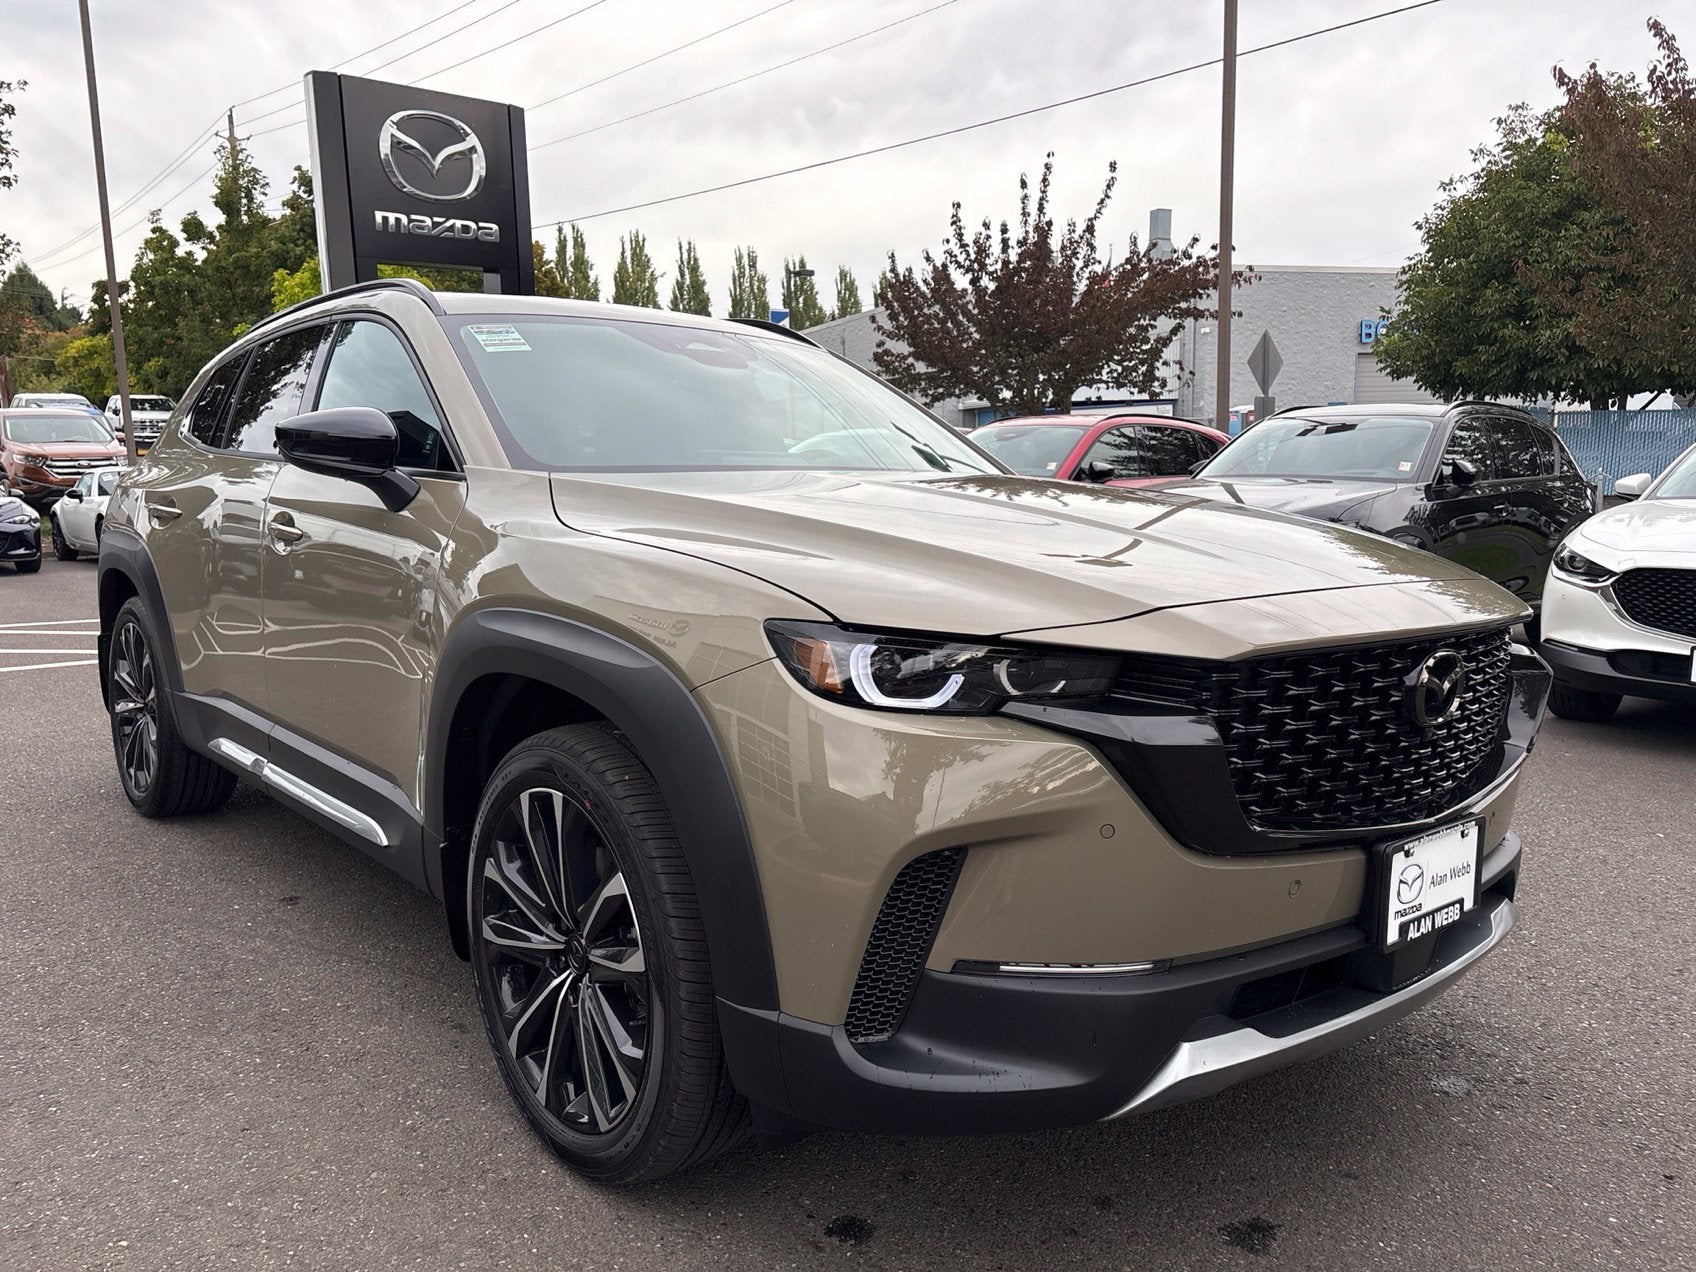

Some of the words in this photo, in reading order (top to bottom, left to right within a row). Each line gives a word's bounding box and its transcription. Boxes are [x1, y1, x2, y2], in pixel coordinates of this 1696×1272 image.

[1429, 873, 1448, 889] Alan
[1449, 860, 1471, 879] Webb
[1407, 914, 1433, 941] ALAN
[1434, 903, 1461, 929] WEBB
